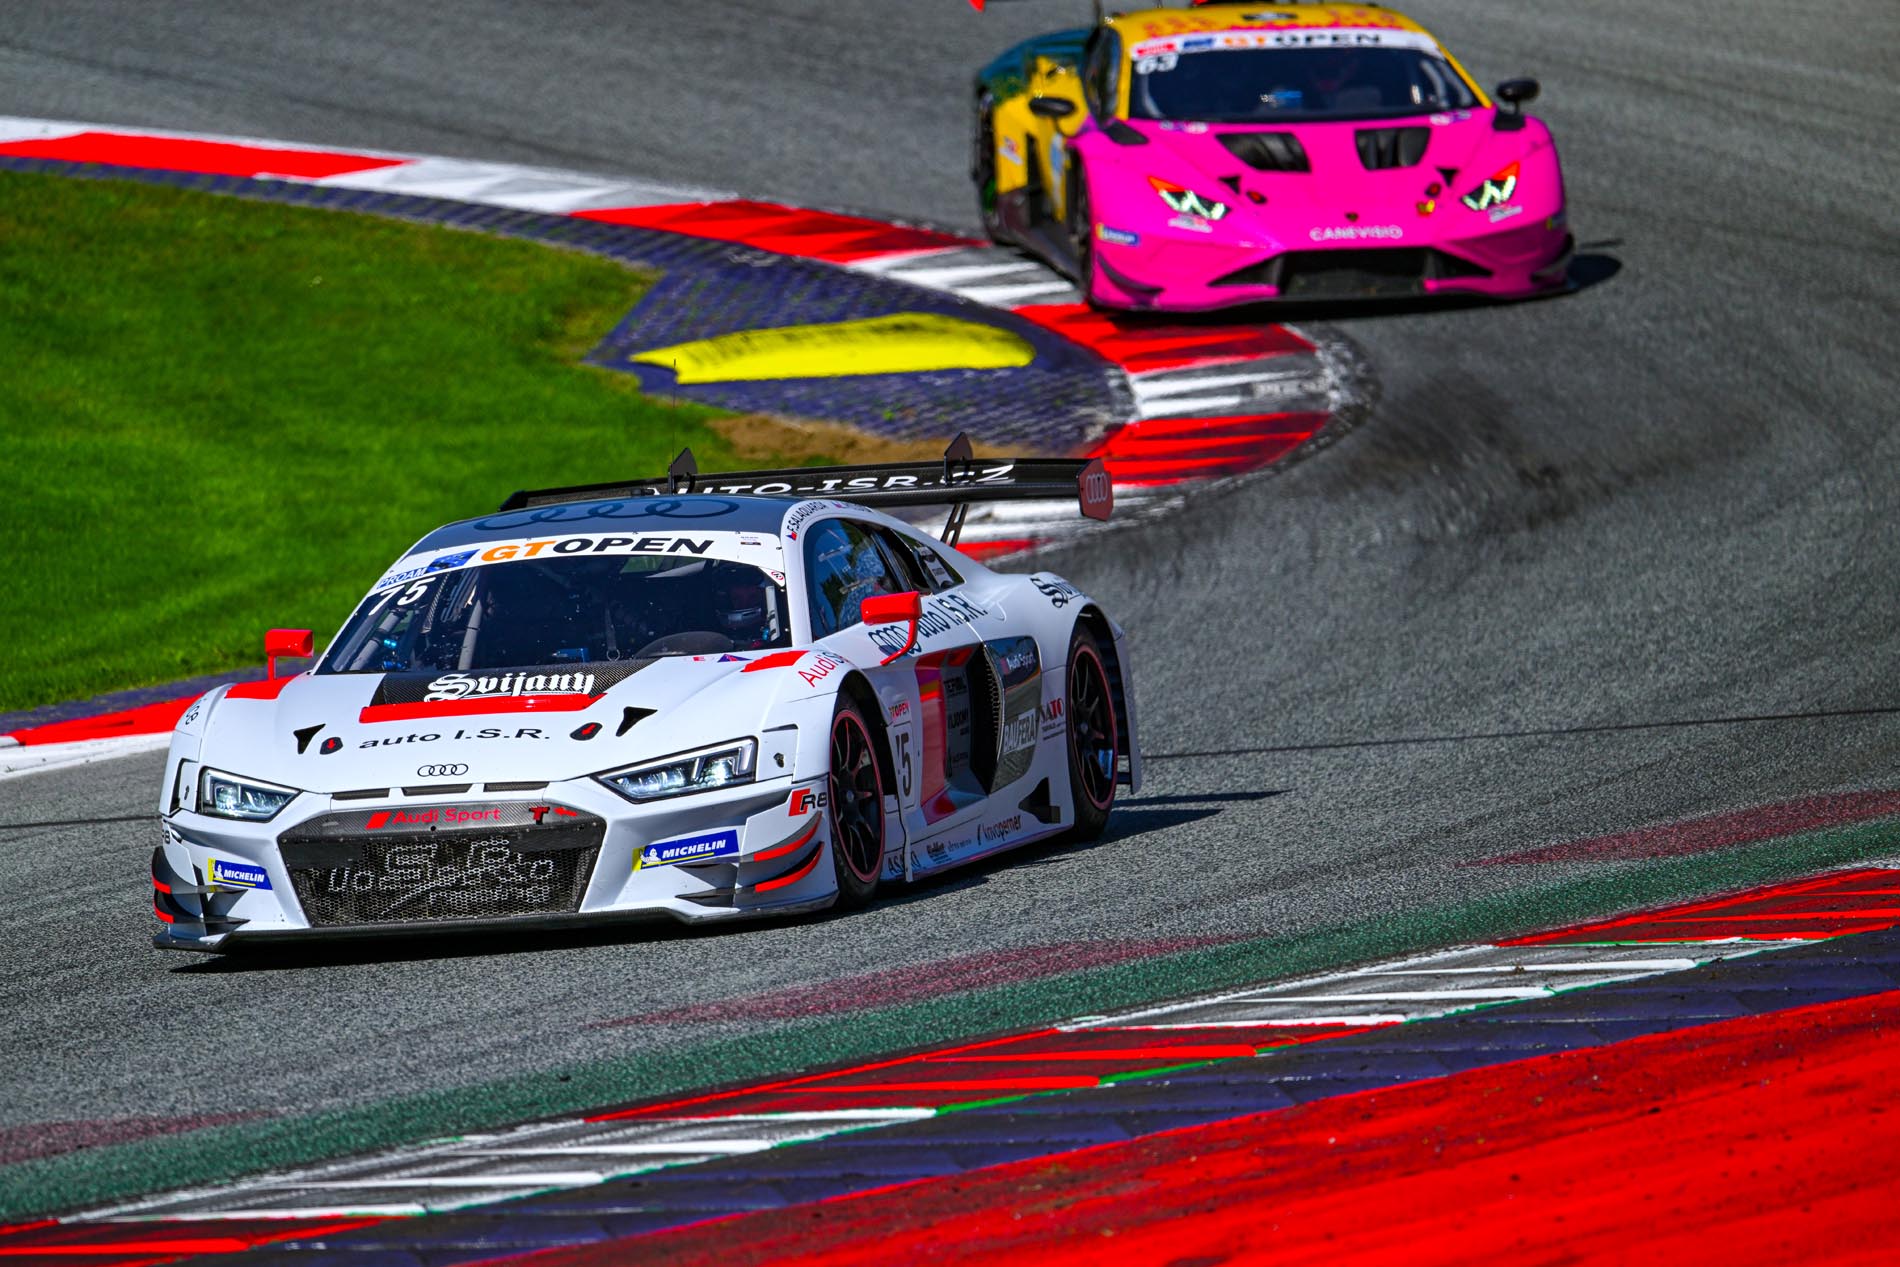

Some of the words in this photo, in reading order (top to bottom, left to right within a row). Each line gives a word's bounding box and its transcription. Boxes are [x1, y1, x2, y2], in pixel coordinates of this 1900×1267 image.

[1135, 52, 1179, 74] 63
[1309, 226, 1404, 241] CANEVISIO
[368, 576, 436, 616] 75
[423, 671, 595, 703] Svijany
[358, 732, 441, 750] auto
[453, 727, 551, 741] I.S.R.
[799, 791, 828, 811] R8
[391, 809, 440, 826] Audi
[444, 807, 501, 824] Sport
[661, 839, 727, 859] MICHELIN
[223, 868, 266, 884] MICHELIN
